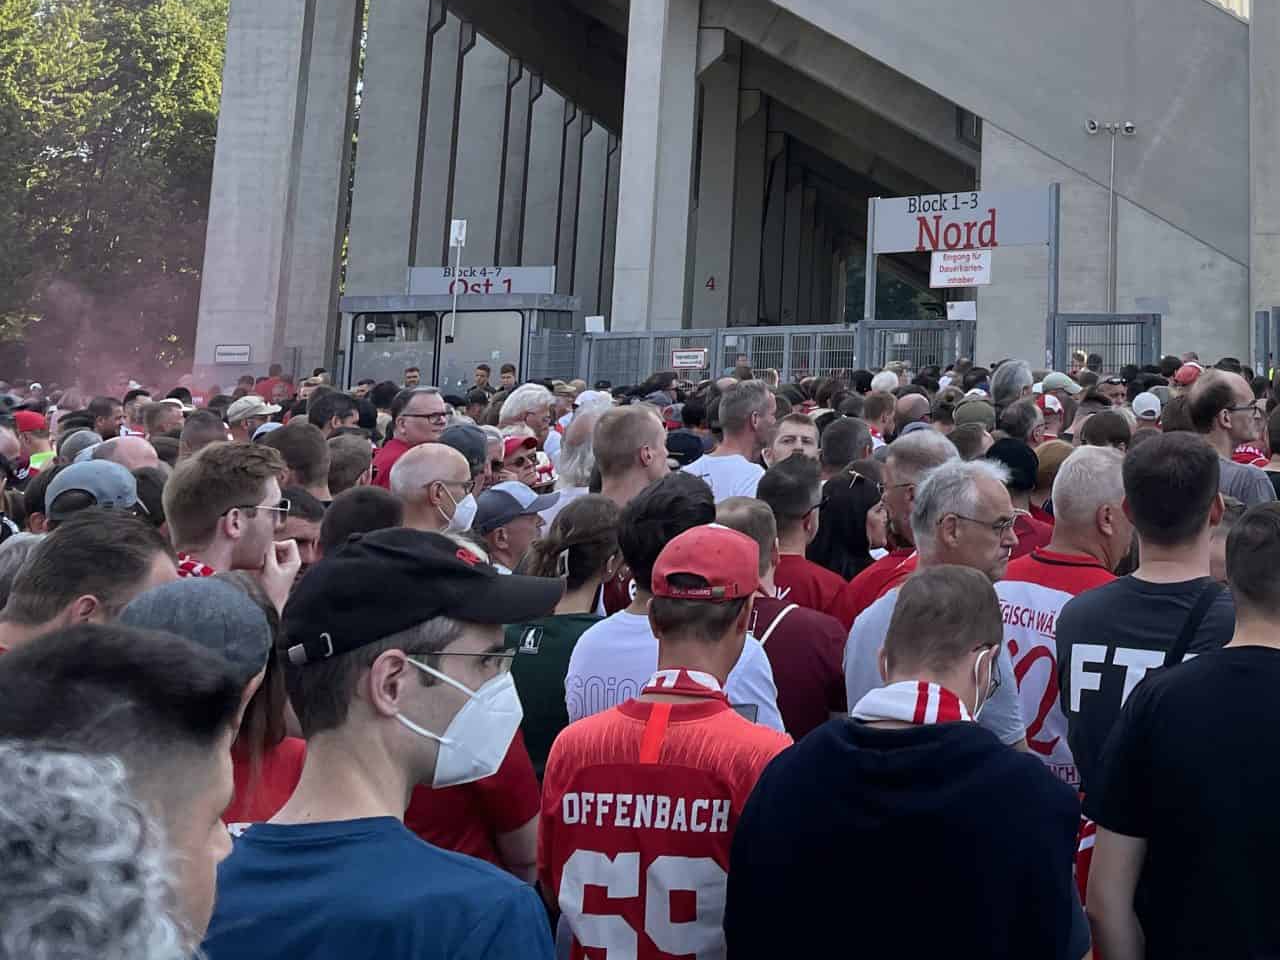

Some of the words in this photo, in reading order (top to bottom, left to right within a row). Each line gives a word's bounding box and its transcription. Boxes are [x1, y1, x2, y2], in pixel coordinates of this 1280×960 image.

[907, 195, 948, 214] Block
[951, 192, 979, 210] 1-3
[916, 207, 998, 252] Nord
[443, 267, 477, 278] Block
[705, 276, 716, 290] 4
[562, 792, 732, 833] OFFENBACH
[558, 849, 729, 960] 69
